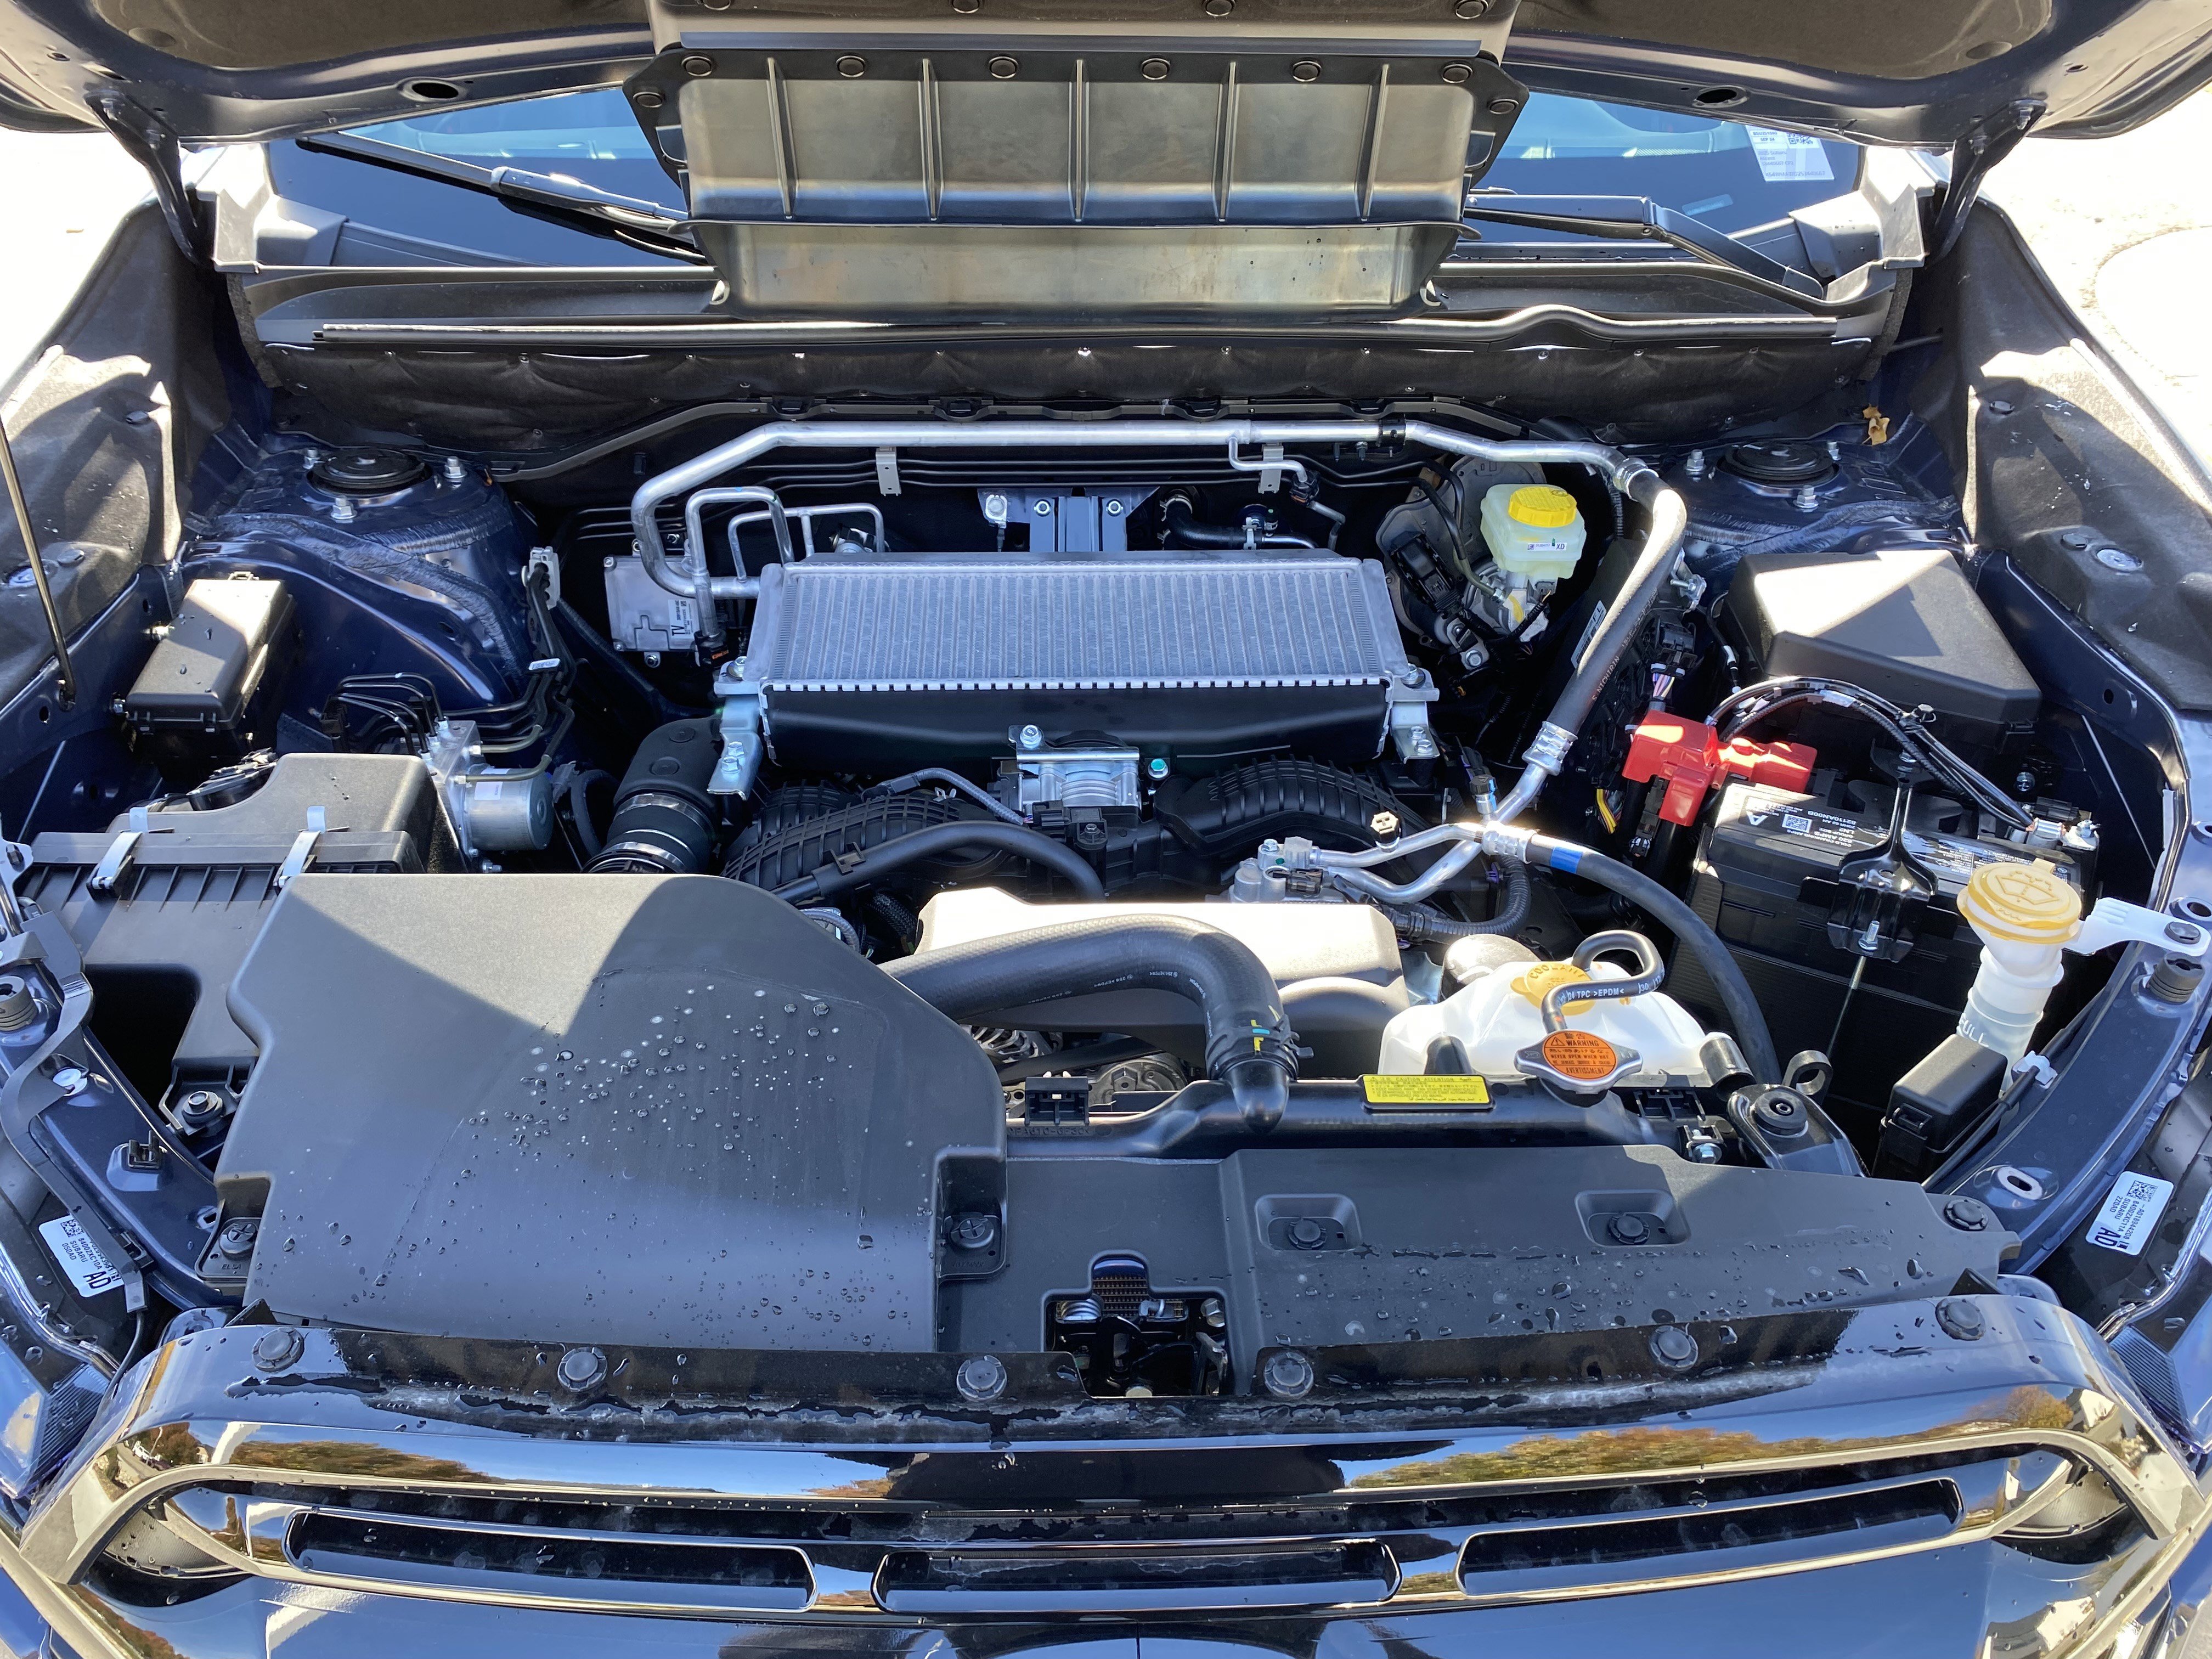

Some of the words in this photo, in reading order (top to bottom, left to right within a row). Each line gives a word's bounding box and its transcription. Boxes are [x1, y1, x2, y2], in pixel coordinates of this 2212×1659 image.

[670, 625, 685, 636] TV
[1814, 831, 1837, 840] AMPS
[1529, 964, 1587, 979] COOLANT
[1577, 990, 1590, 998] TPC
[1593, 988, 1624, 997] >EPDM<
[2114, 1198, 2131, 1220] SUBARU
[2095, 1227, 2121, 1247] AD
[70, 1240, 89, 1262] SUBARU
[77, 1238, 102, 1270] 84002XC10A
[83, 1271, 112, 1290] AD
